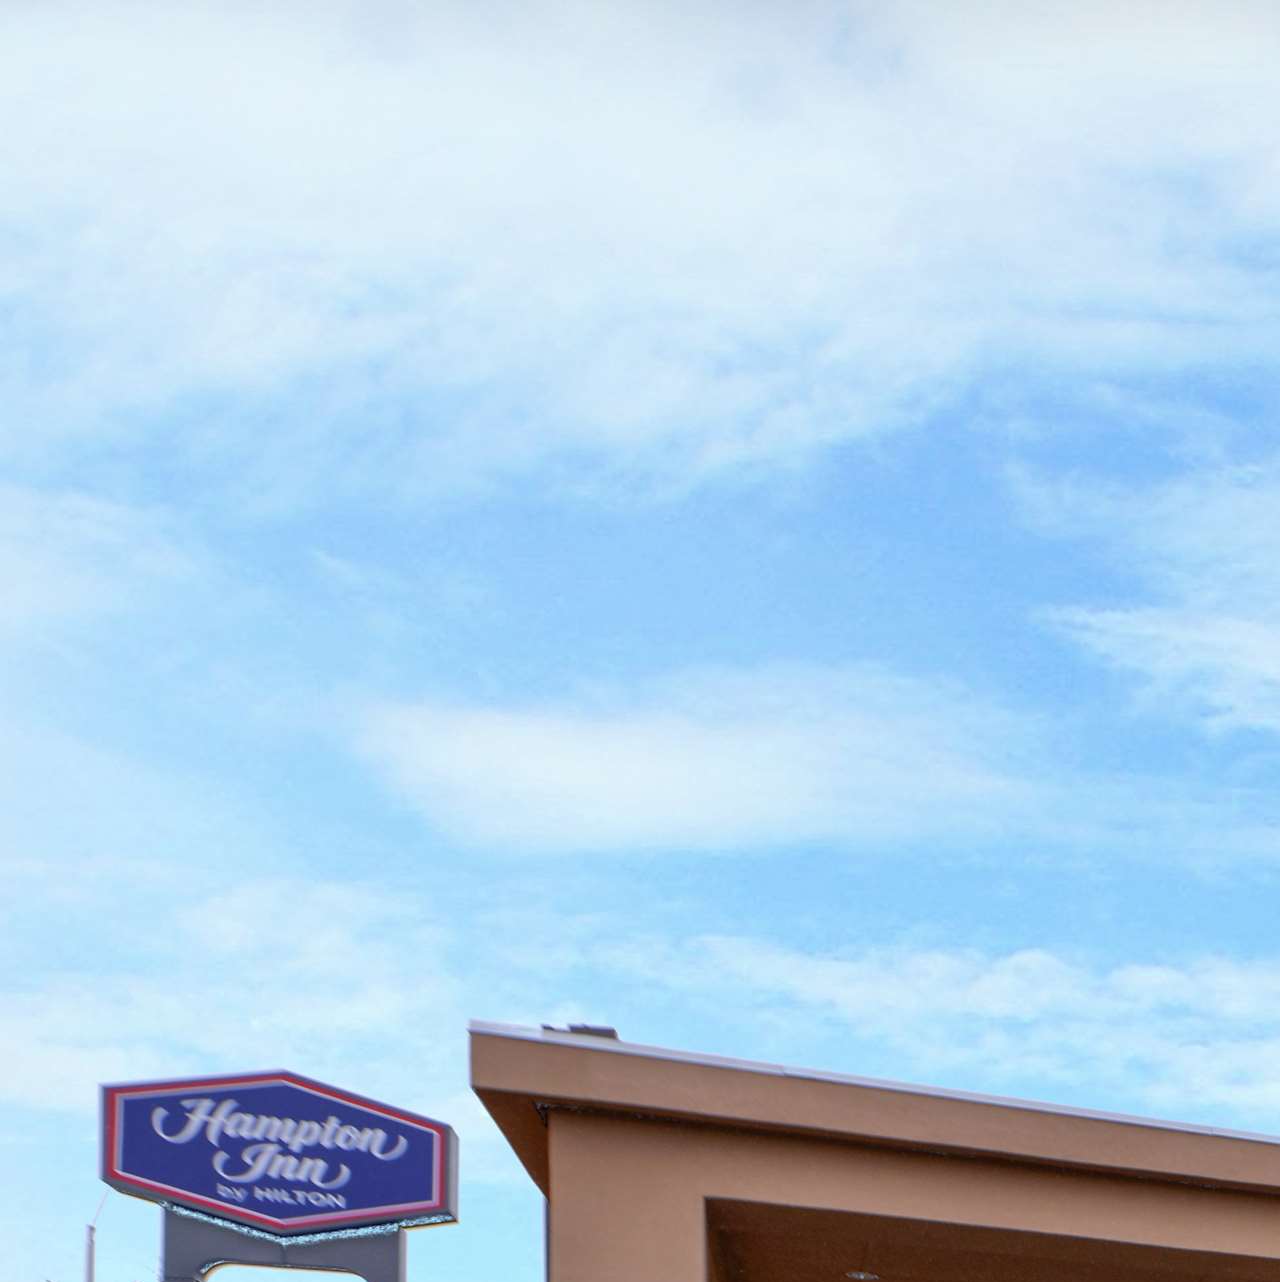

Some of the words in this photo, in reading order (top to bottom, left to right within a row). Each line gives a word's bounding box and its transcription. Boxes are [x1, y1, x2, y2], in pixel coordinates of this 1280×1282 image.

[151, 1098, 408, 1161] Hampton
[212, 1143, 351, 1189] Inn
[253, 1185, 346, 1209] HILTON
